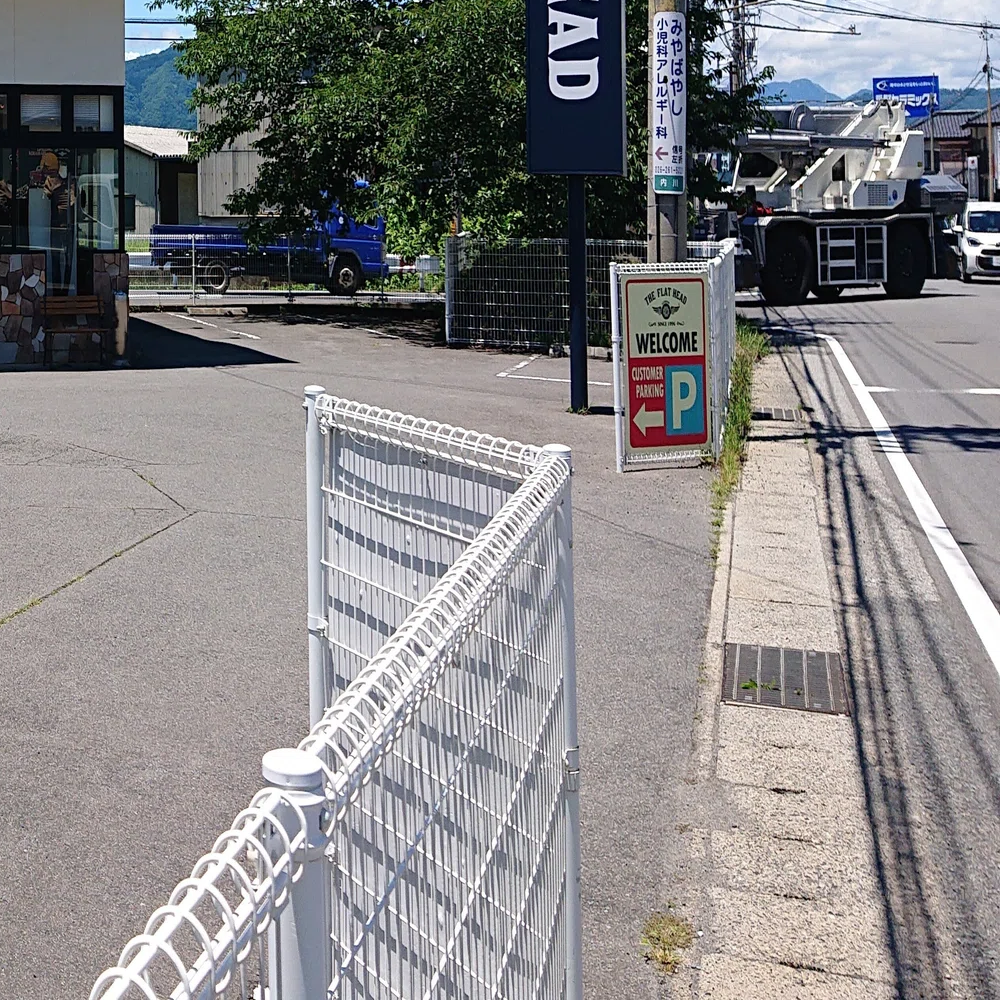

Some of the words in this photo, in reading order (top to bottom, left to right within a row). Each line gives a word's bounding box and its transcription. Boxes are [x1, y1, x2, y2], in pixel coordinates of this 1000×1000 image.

[656, 18, 668, 139] 小児科アレルギー科
[670, 19, 684, 116] みやばやし
[644, 291, 656, 306] THE
[657, 287, 671, 297] FLAT
[672, 288, 687, 305] HEAD
[636, 332, 698, 354] WELCOME
[632, 366, 664, 381] CUSTOMER
[636, 383, 664, 399] PARKING
[672, 371, 697, 430] P
